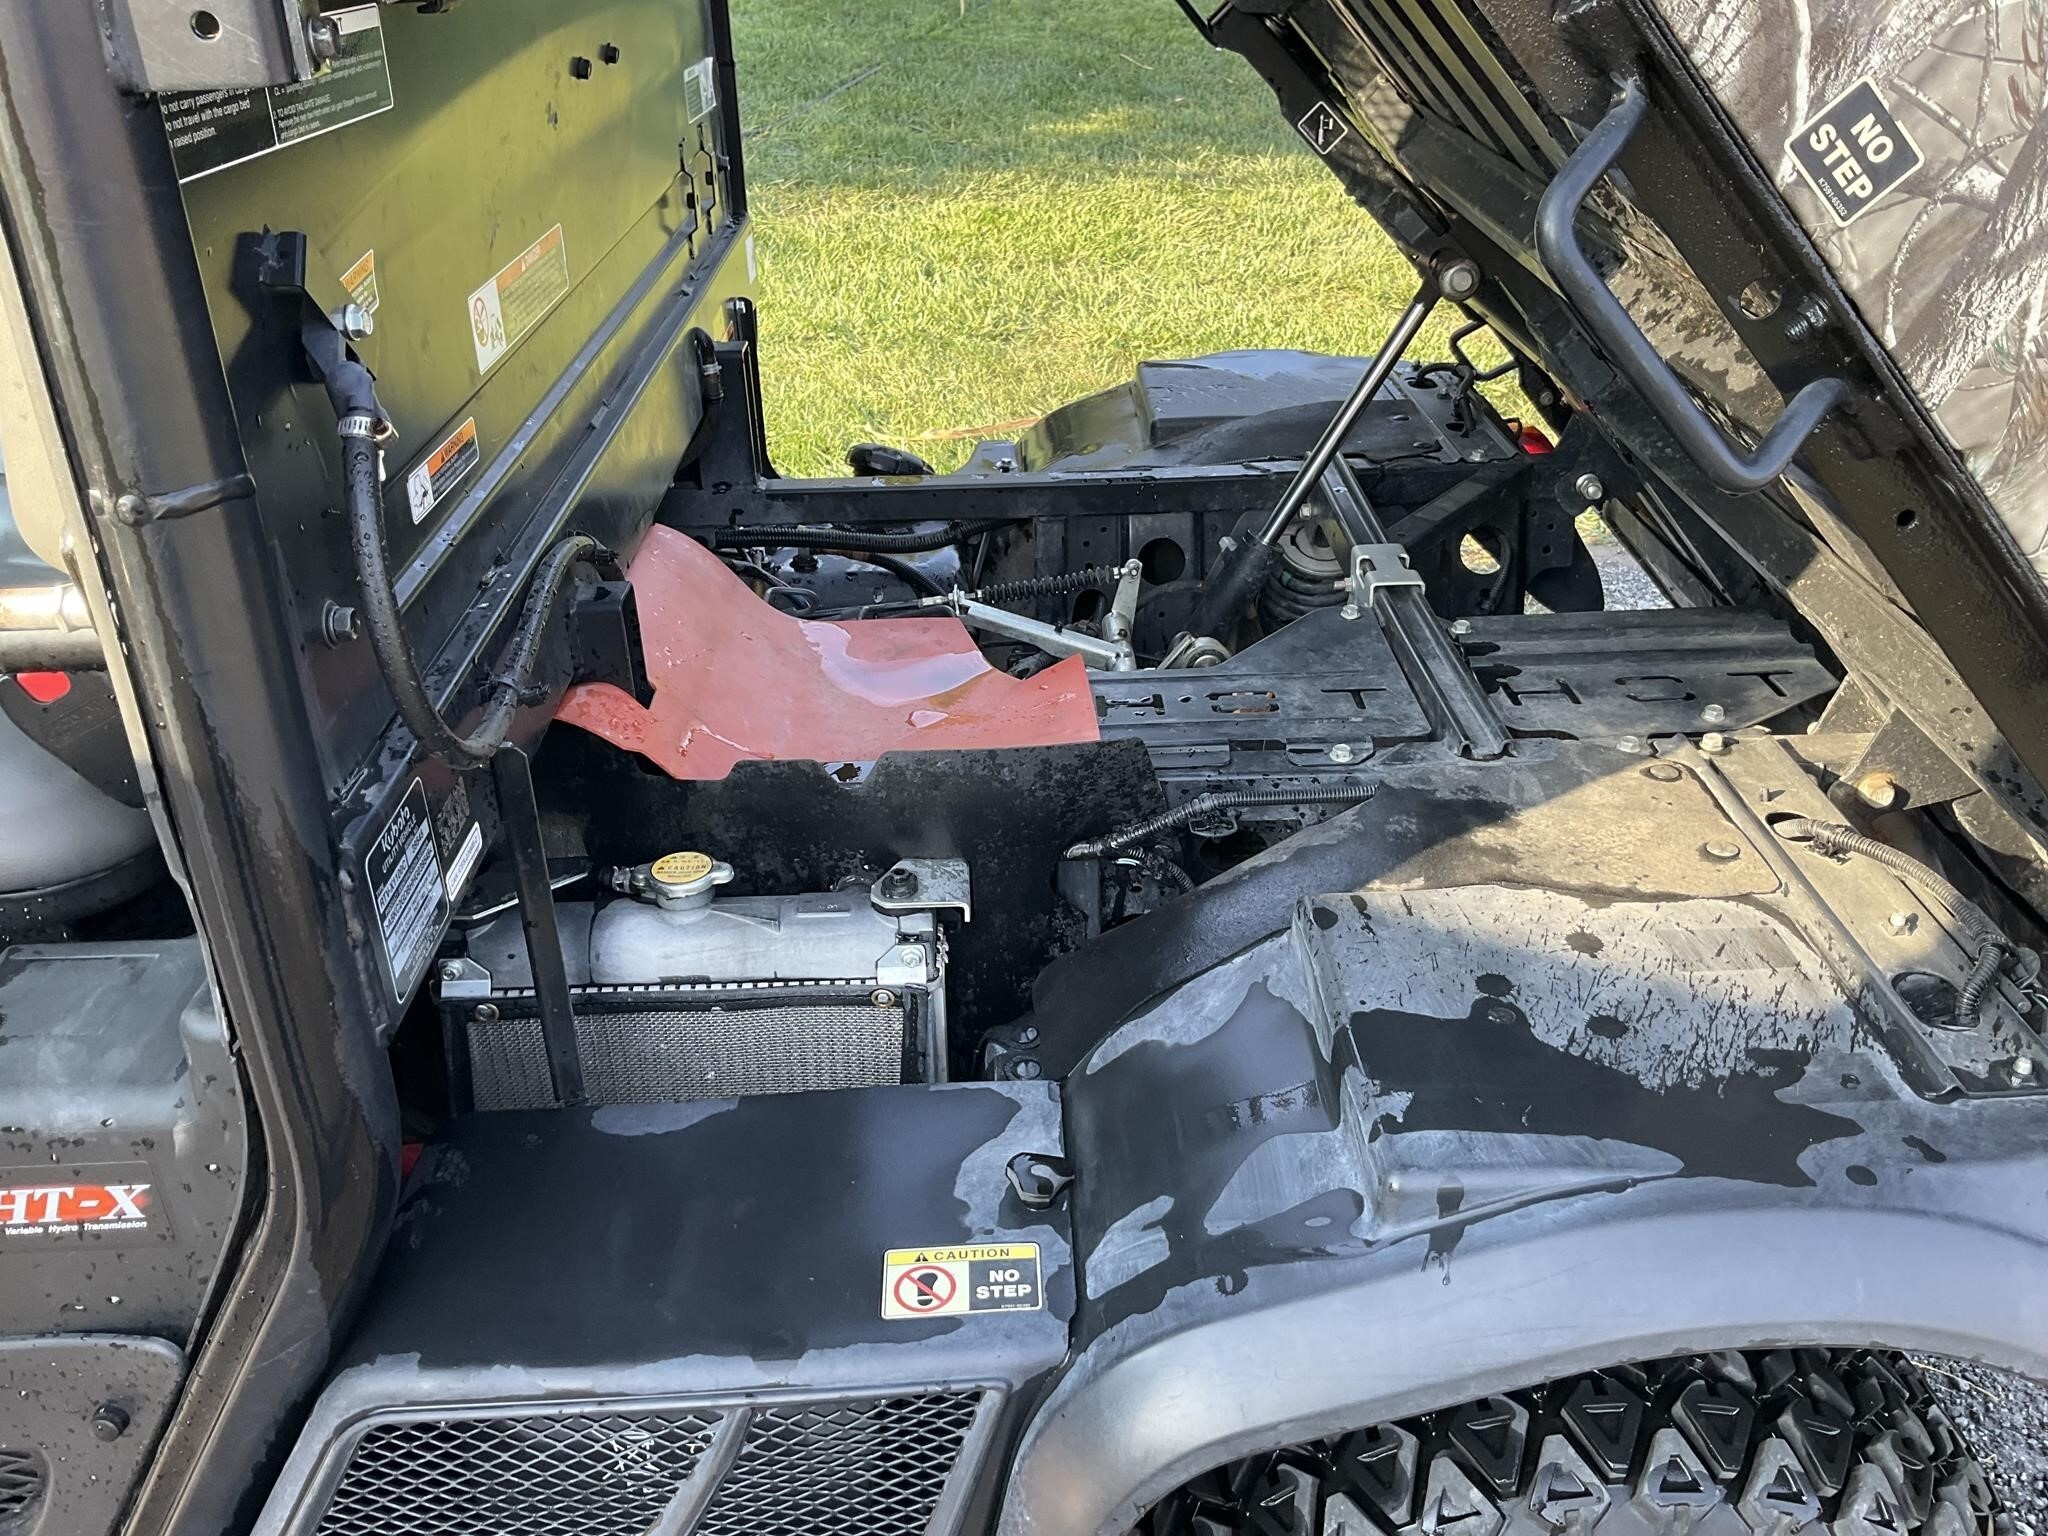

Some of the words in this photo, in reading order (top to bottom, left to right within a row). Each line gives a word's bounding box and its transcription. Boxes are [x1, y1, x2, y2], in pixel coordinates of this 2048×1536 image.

[168, 100, 180, 112] not
[180, 97, 195, 110] carry
[195, 89, 229, 108] passengers
[172, 116, 184, 130] not
[183, 112, 200, 126] travel
[200, 107, 213, 121] with
[212, 106, 223, 118] the
[223, 102, 239, 115] cargo
[239, 96, 250, 110] bed
[173, 131, 192, 148] raised
[1850, 112, 1894, 164] NO
[1810, 123, 1873, 199] STEP
[381, 806, 411, 853] Kubota
[382, 842, 399, 874] UTILITY
[5, 1226, 43, 1235] Variable
[48, 1224, 78, 1234] Hydro
[83, 1221, 147, 1231] Transmission
[934, 1248, 1010, 1261] CAUTION
[990, 1269, 1020, 1282] NO
[976, 1284, 1032, 1299] STEP
